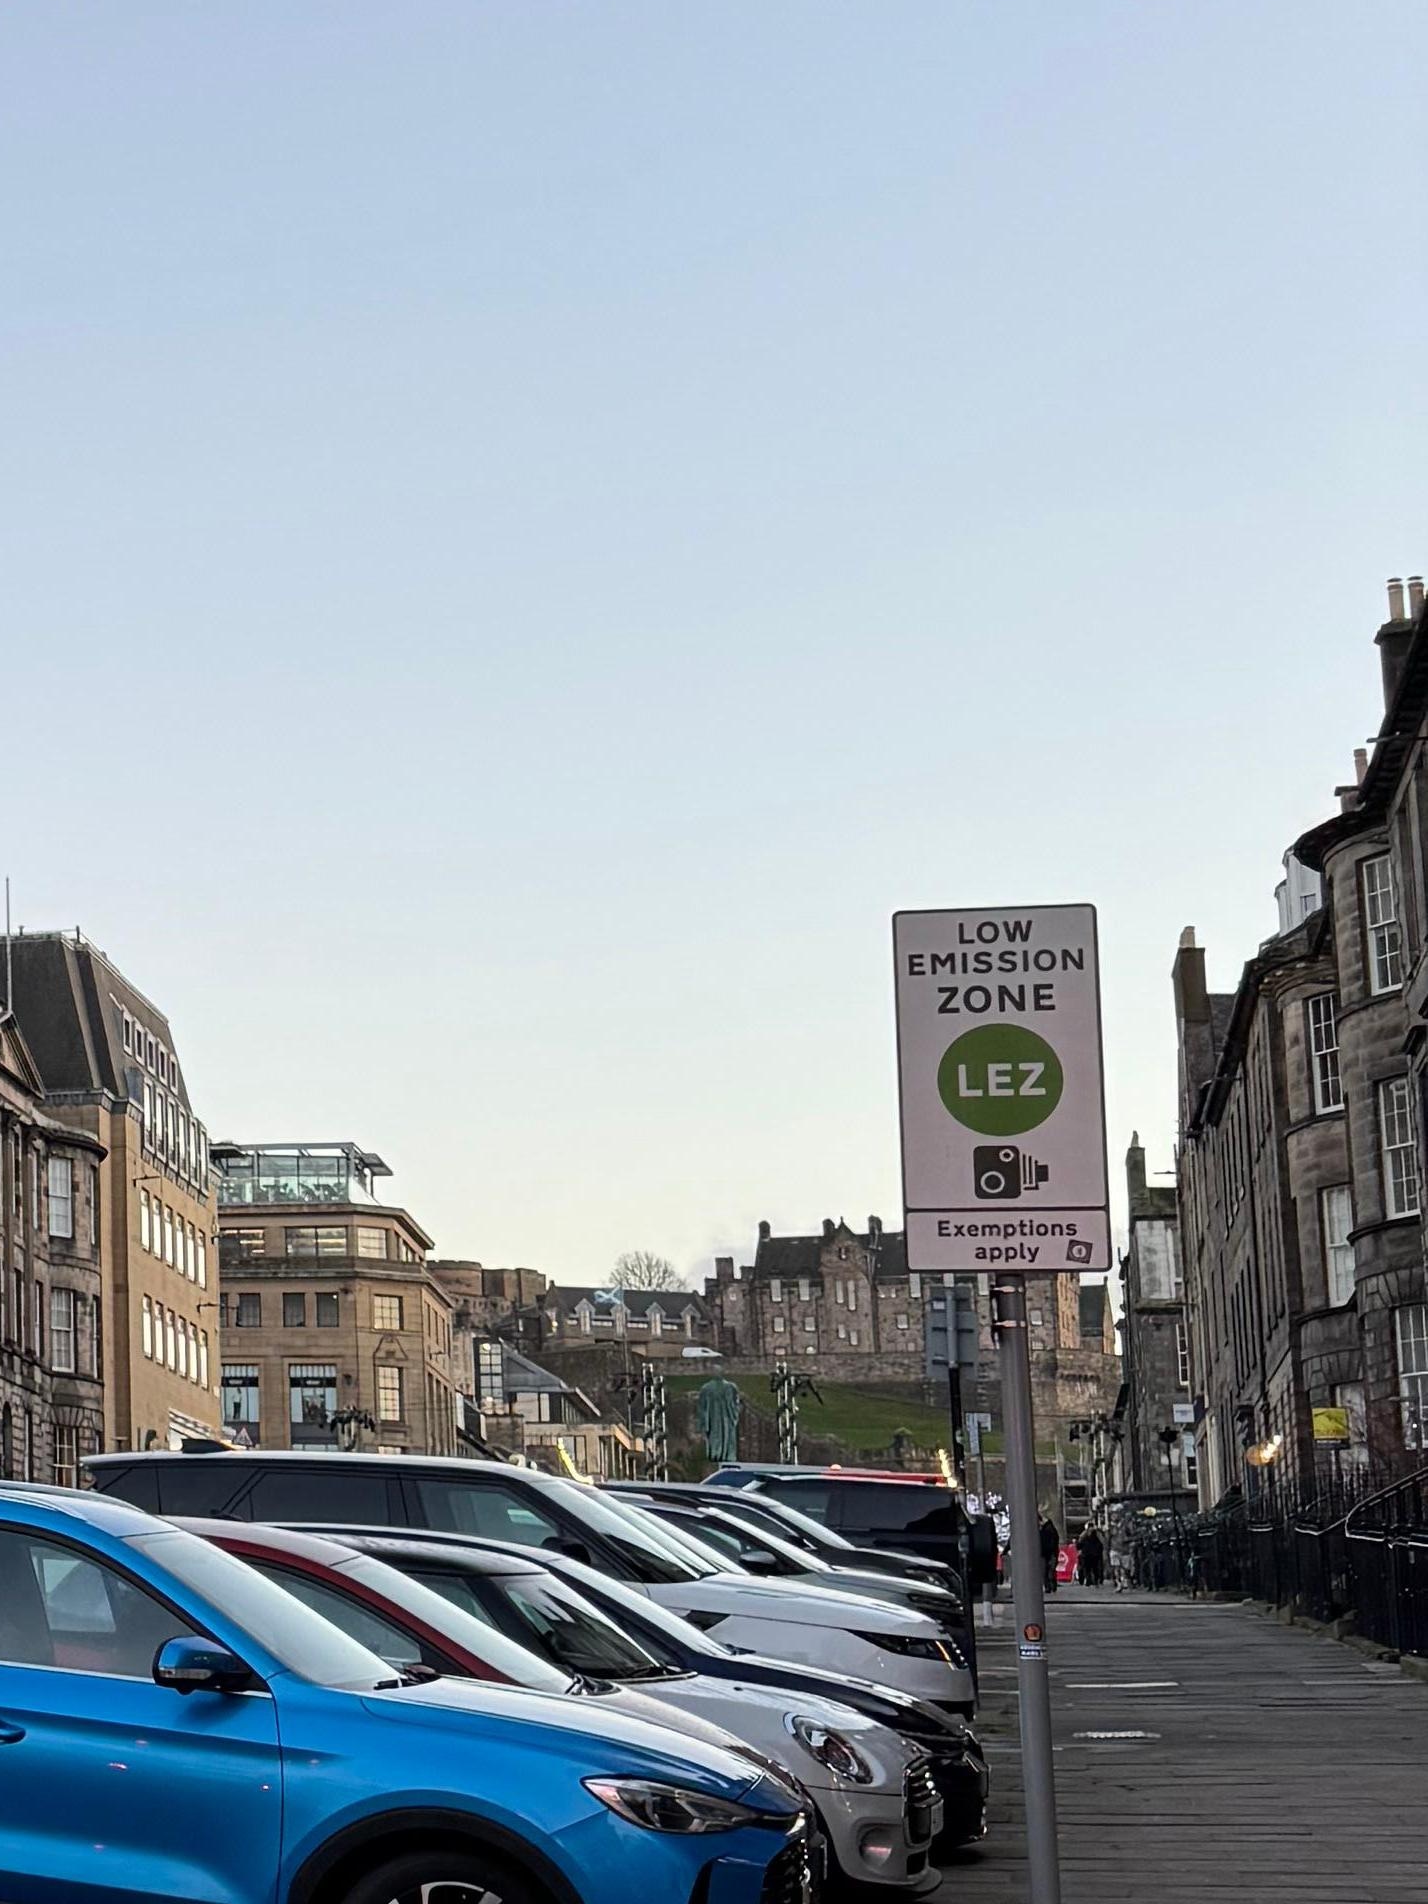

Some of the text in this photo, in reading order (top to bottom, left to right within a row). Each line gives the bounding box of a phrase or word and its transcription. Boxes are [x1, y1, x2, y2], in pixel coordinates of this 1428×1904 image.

[958, 919, 1034, 945] LOW
[908, 948, 1085, 976] EMISSION
[937, 983, 1056, 1015] ZONE
[957, 1061, 1046, 1097] LEZ
[937, 1219, 1078, 1241] Exemptions
[974, 1241, 1040, 1263] apply
